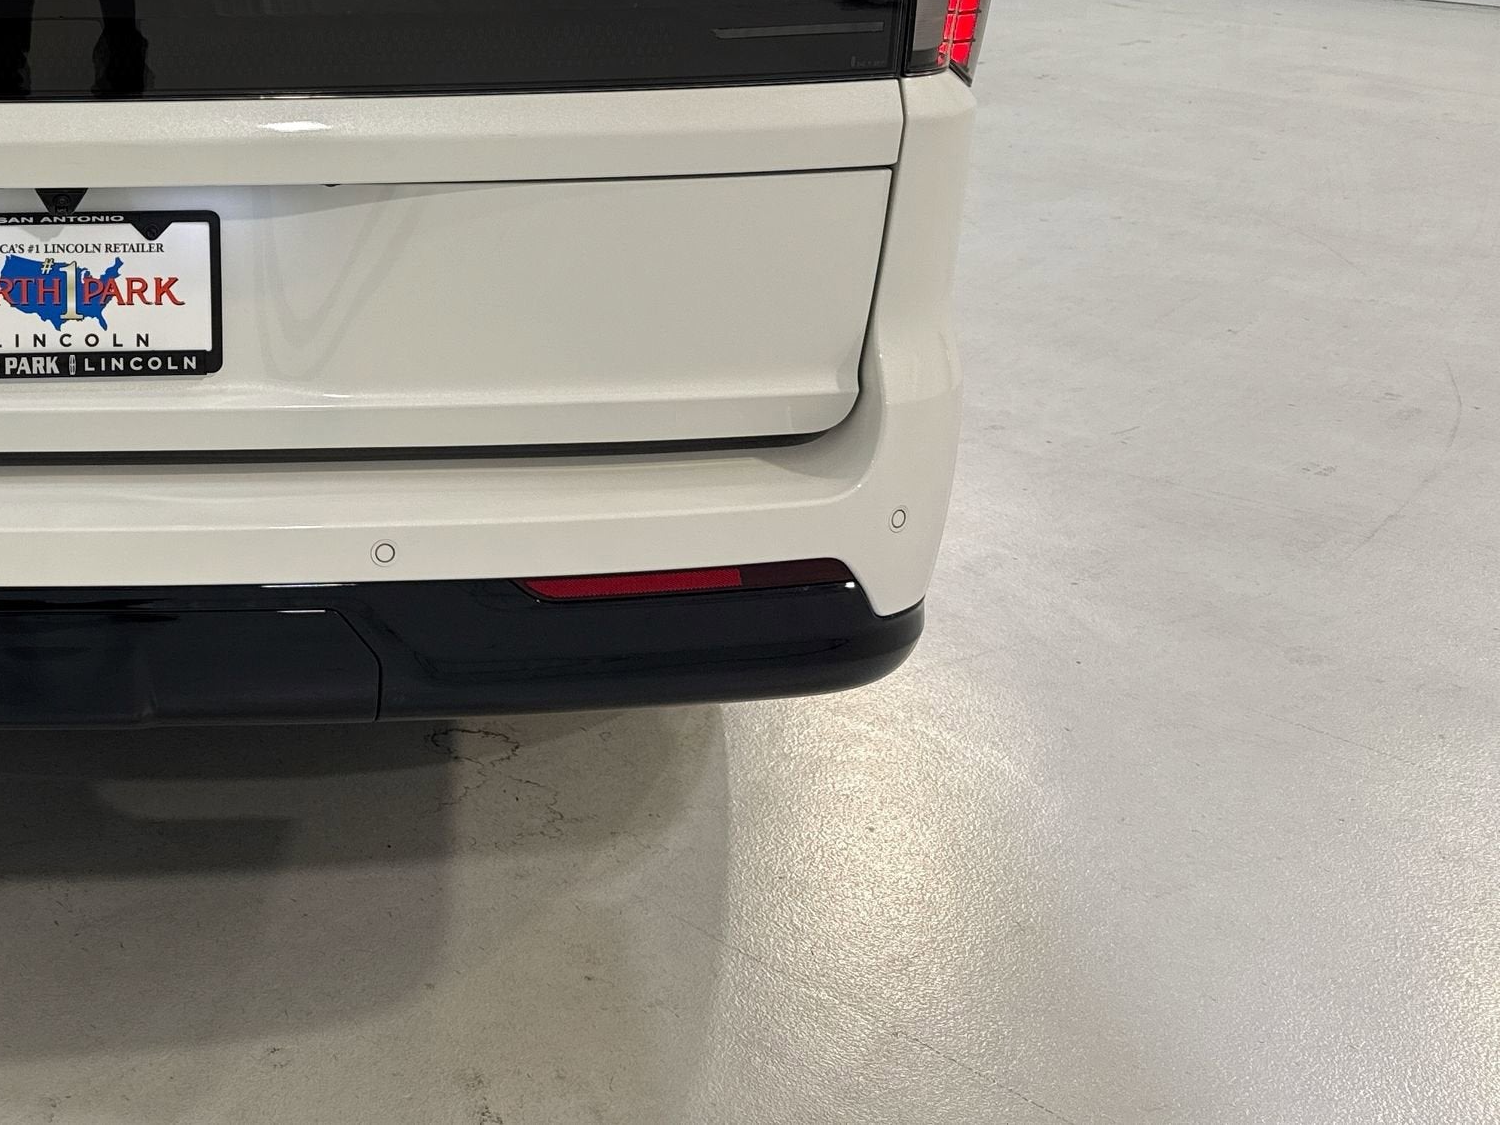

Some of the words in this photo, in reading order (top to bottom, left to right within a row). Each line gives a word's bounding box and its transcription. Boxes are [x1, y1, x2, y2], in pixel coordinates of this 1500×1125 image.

[40, 215, 125, 223] ANTONIO
[27, 243, 40, 254] #1
[43, 242, 102, 254] LINCOLN
[104, 242, 165, 254] RETAILER
[83, 276, 186, 306] PARK
[4, 356, 60, 375] PARK
[84, 356, 197, 372] LINCOLN
